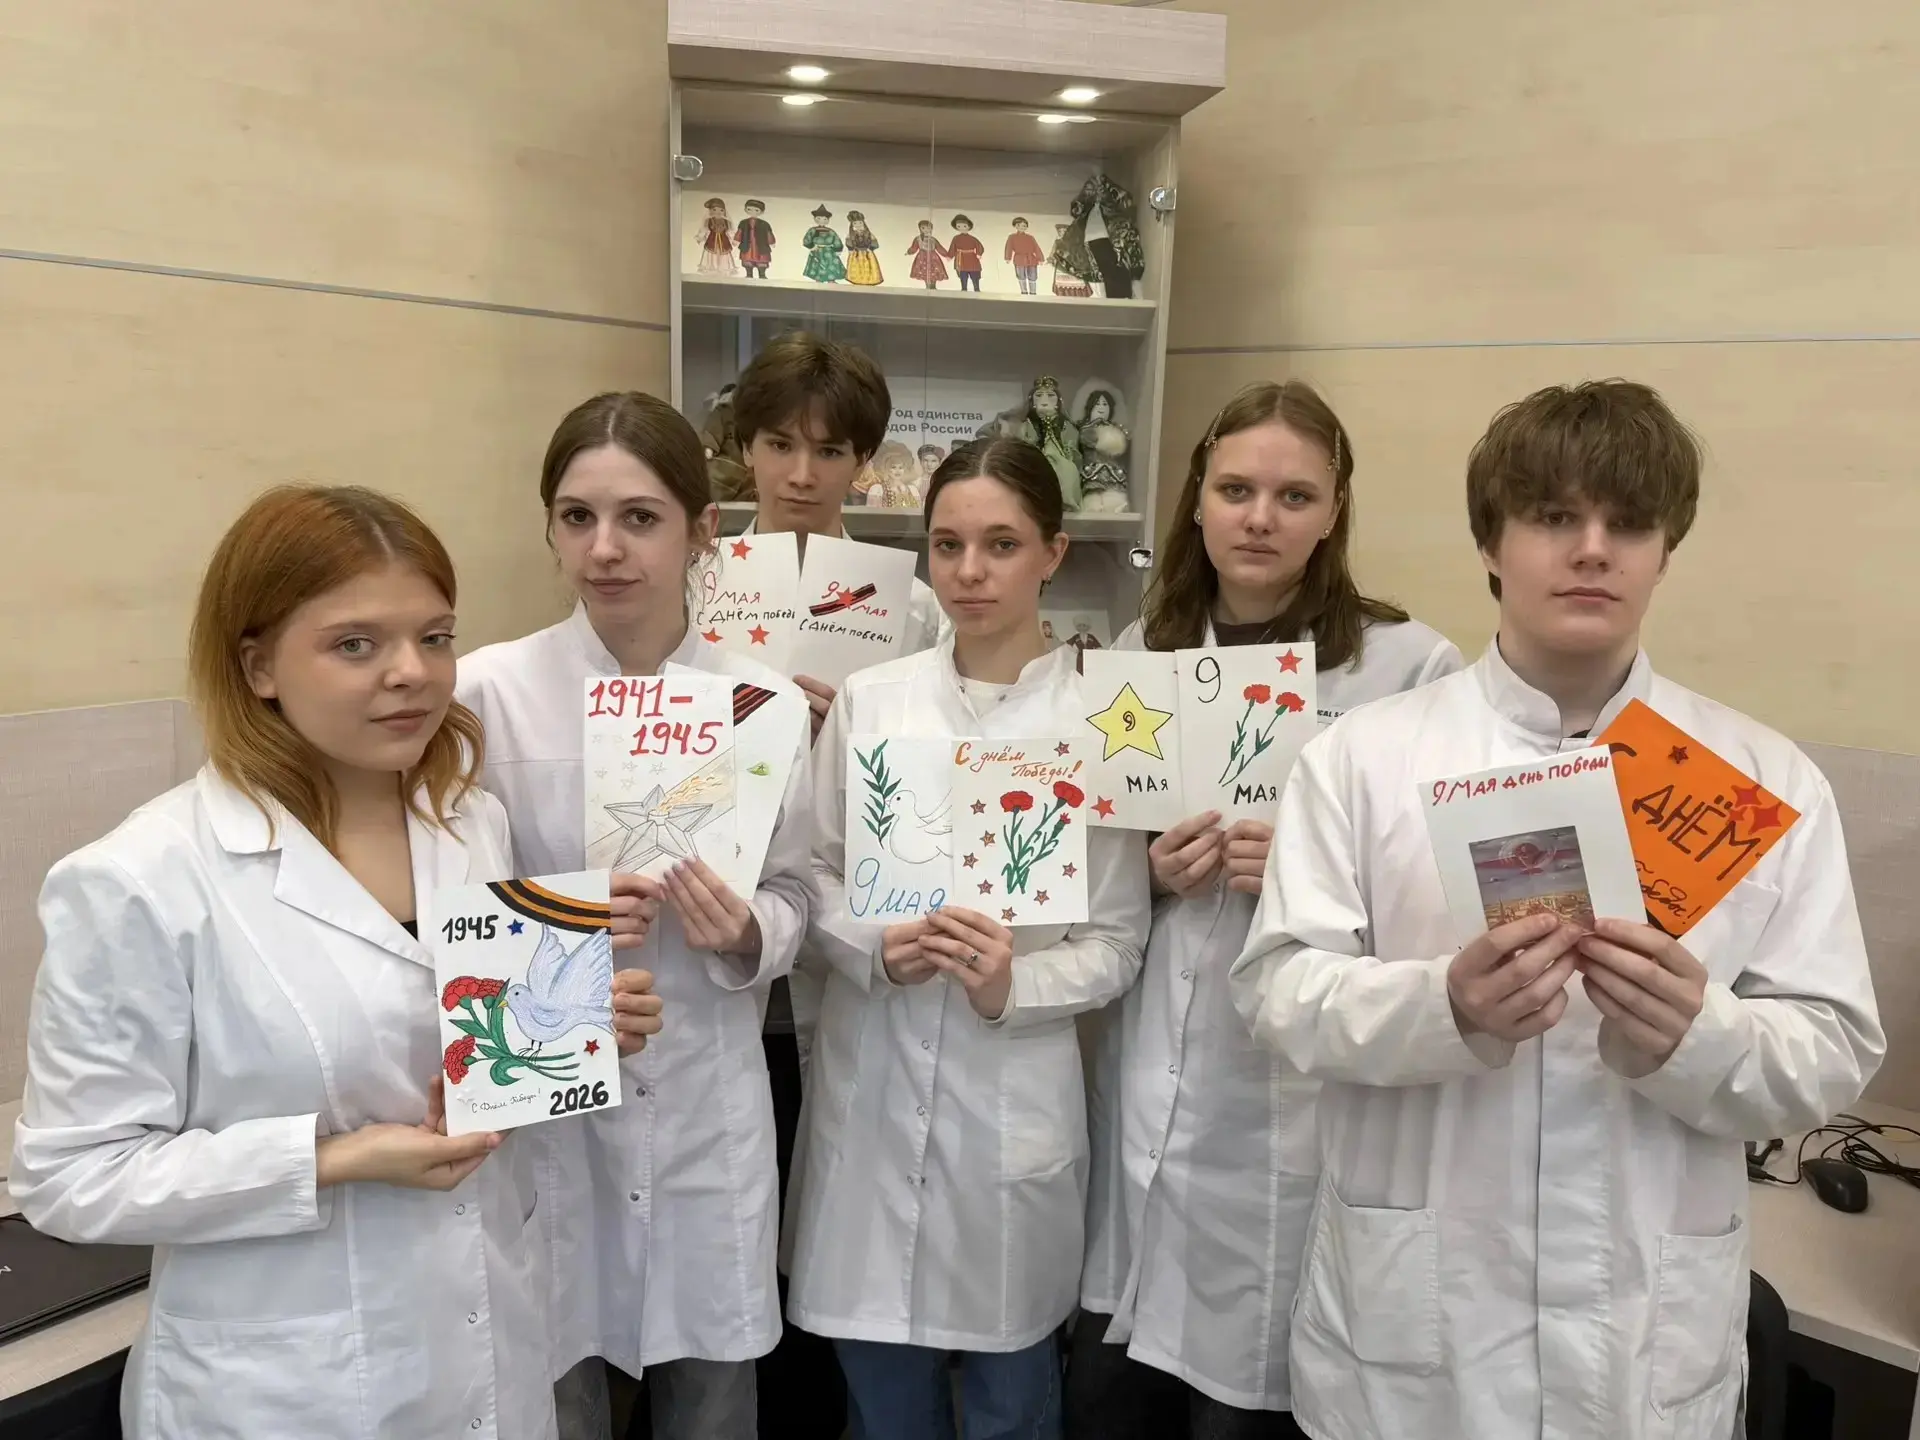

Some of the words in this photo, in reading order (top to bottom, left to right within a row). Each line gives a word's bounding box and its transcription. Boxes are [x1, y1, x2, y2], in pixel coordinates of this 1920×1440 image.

[917, 409, 983, 421] единства
[921, 422, 972, 434] России
[703, 570, 717, 605] 9
[821, 580, 840, 599] 9
[1194, 656, 1221, 704] 9
[1121, 711, 1137, 732] 9
[629, 721, 723, 756] 1945
[970, 745, 1025, 773] днём
[1011, 760, 1083, 785] Победы!
[1432, 780, 1446, 806] 9
[1502, 770, 1544, 789] день
[1631, 784, 1761, 881] ДНЁМ
[849, 857, 880, 917] 9
[441, 915, 499, 944] 1945
[549, 1080, 609, 1116] 2026
